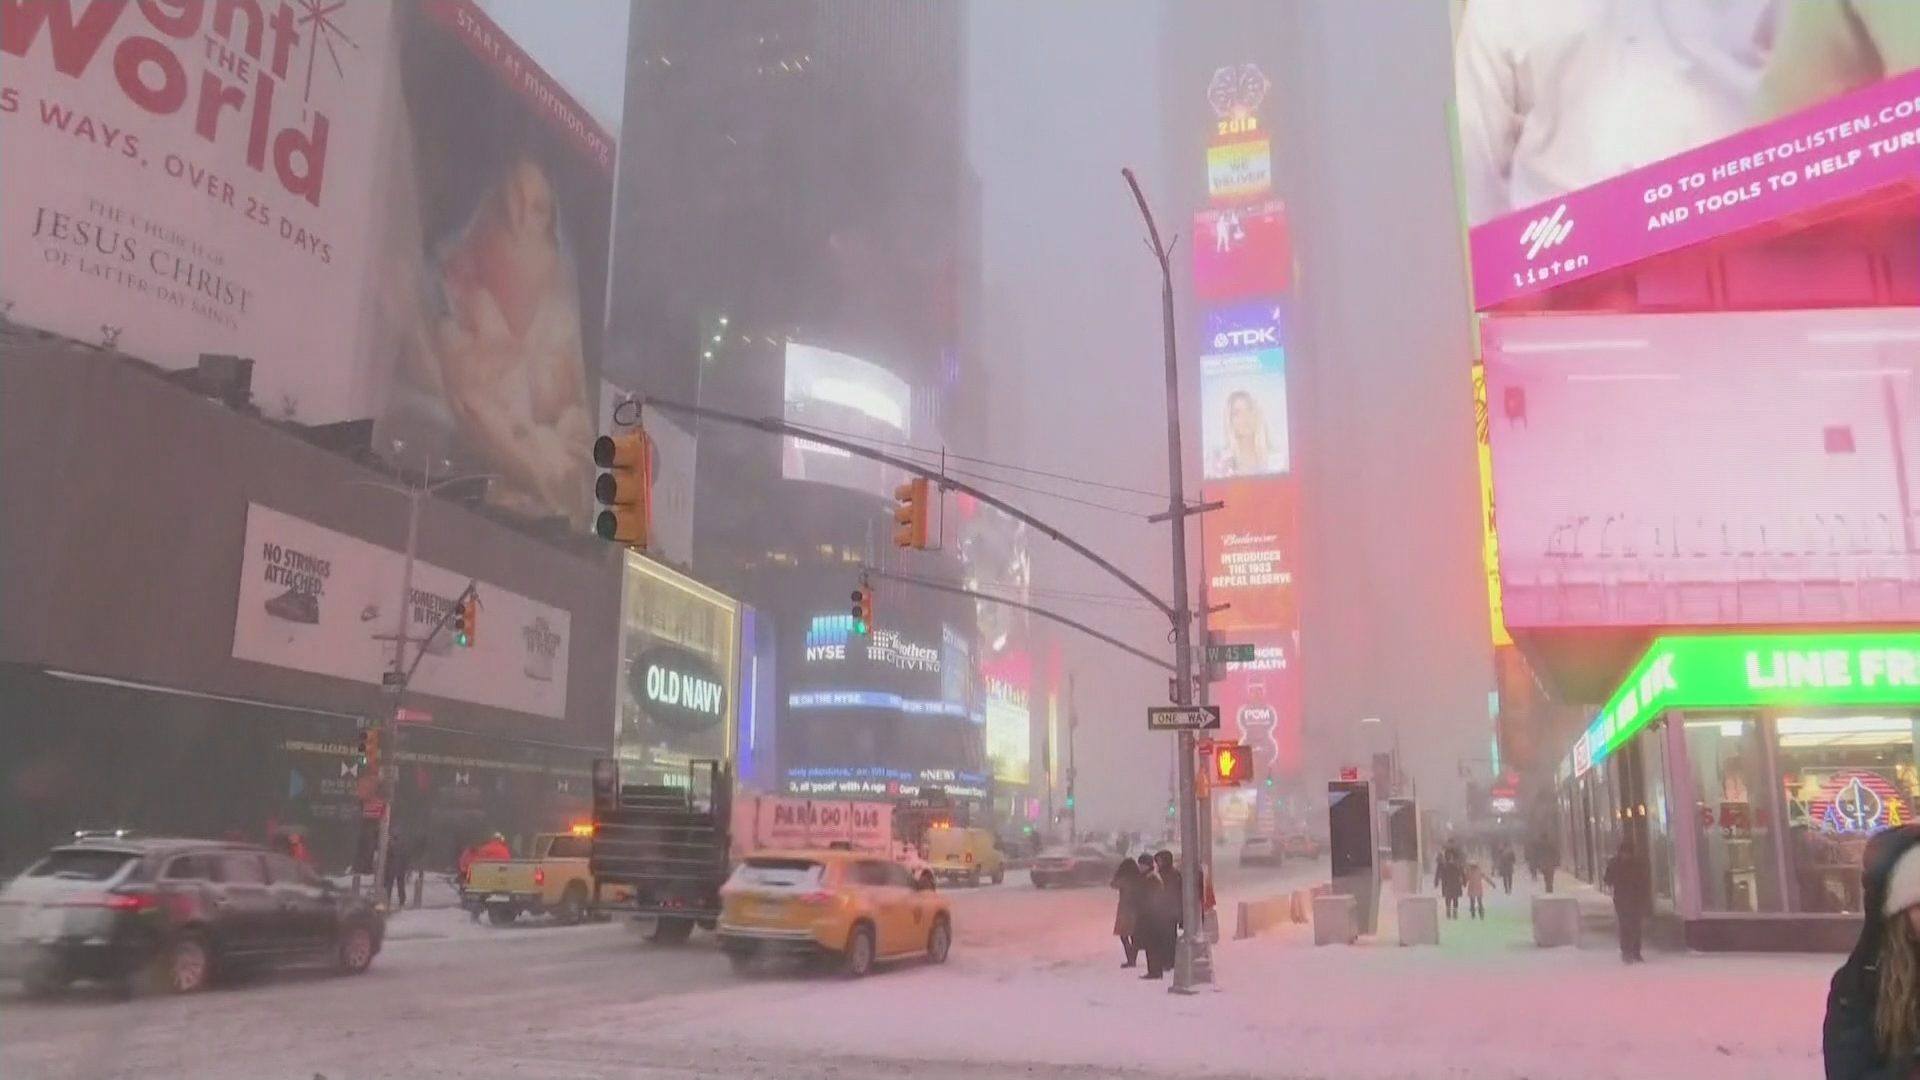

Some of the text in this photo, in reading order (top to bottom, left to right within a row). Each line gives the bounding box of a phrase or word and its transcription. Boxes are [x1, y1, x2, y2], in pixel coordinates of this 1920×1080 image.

[204, 34, 250, 84] THE
[456, 7, 609, 164] START AT mormon.org
[1643, 183, 1673, 204] GO
[1678, 171, 1706, 192] TO
[1647, 205, 1689, 232] AND
[1695, 182, 1762, 215] TOOLS
[1768, 170, 1798, 192] TO
[1804, 149, 1862, 181] HELP
[164, 155, 235, 206] OVER
[246, 196, 271, 227] 25
[279, 217, 333, 266] DAYS
[32, 207, 251, 312] JESUS CHRIST
[44, 249, 71, 267] OF
[1513, 253, 1589, 288] listen
[1227, 326, 1277, 346] TDK
[263, 542, 331, 579] NO STRINGS
[1221, 550, 1281, 565] INTRODUCES
[264, 563, 326, 597] ATTACHED.
[1229, 564, 1248, 576] THE
[1212, 573, 1292, 588] REPEAL RESERVE
[414, 607, 424, 623] IN
[806, 645, 846, 662] NYSE
[1208, 647, 1220, 661] W
[1225, 646, 1239, 661] 45
[1243, 658, 1287, 670] HEALTH
[1745, 650, 1853, 688] LINE
[646, 664, 722, 715] OLD NAVY
[1158, 712, 1209, 724] ONE WAY
[1244, 708, 1271, 720] POM
[839, 781, 861, 792] with
